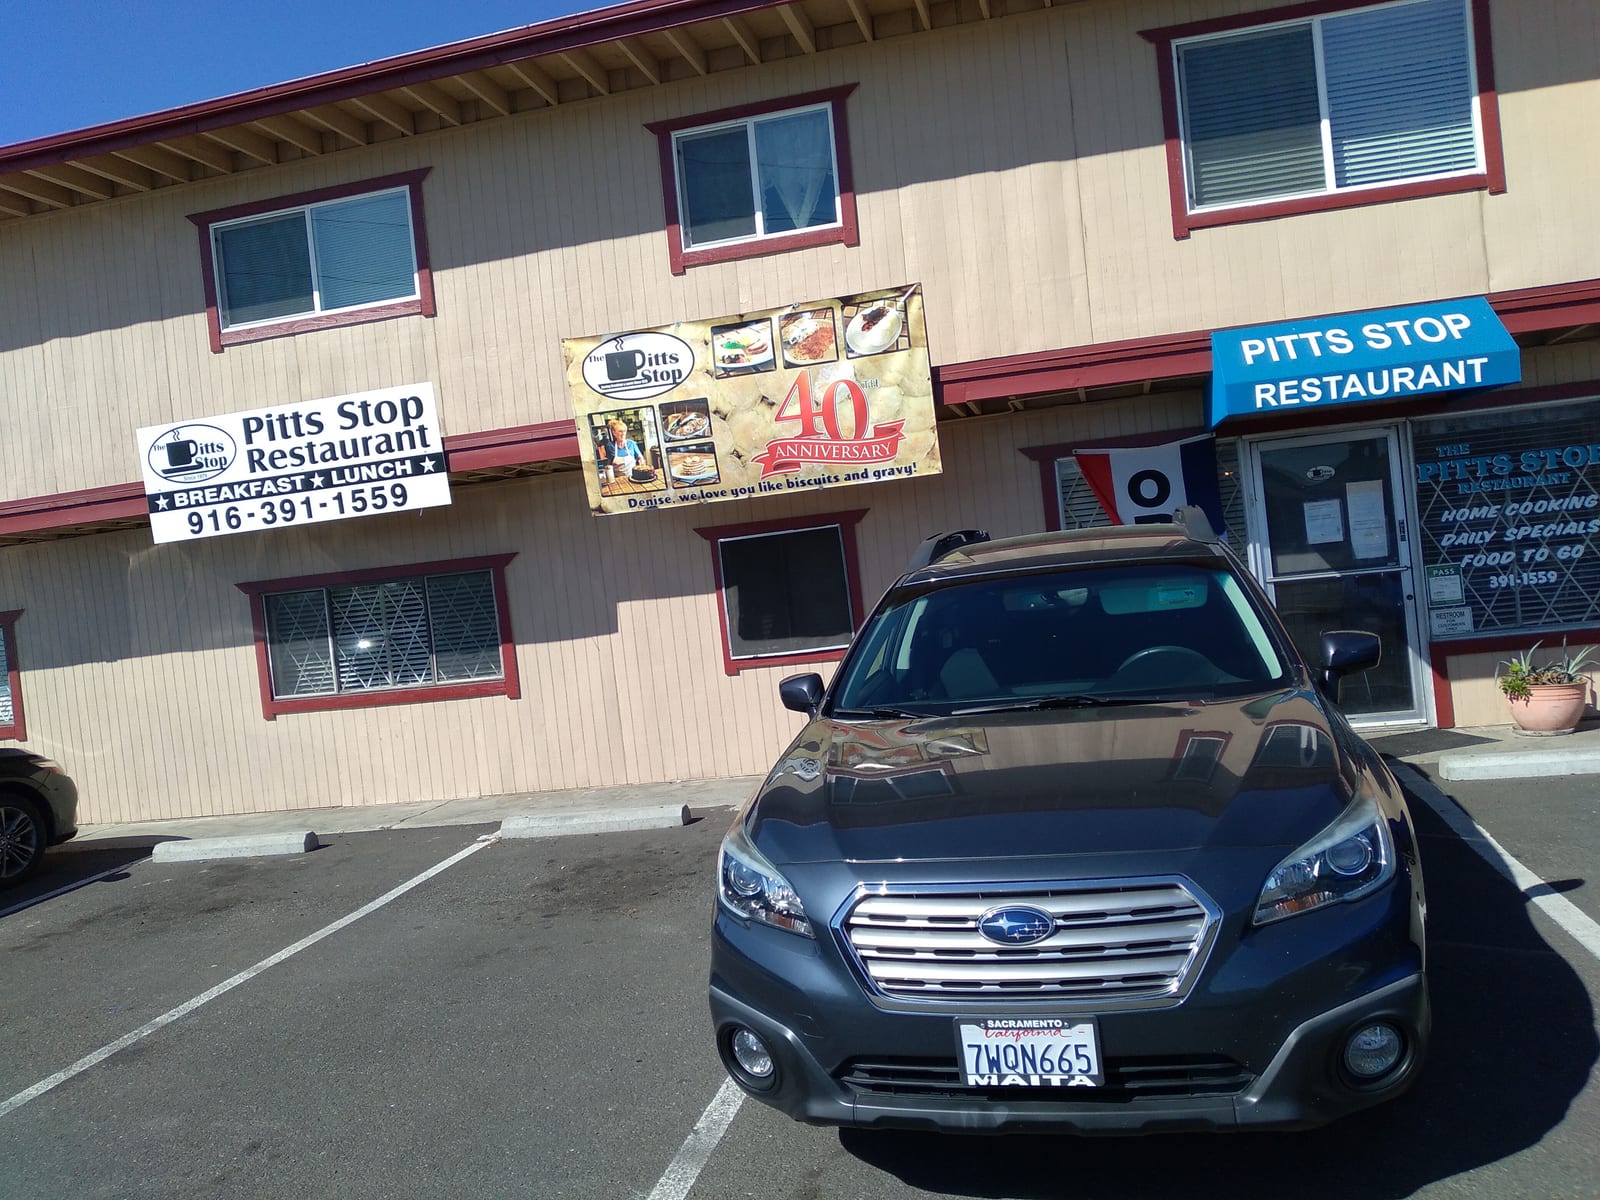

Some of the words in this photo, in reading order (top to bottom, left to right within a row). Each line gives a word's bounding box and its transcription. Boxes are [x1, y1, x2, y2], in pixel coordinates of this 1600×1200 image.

[1241, 329, 1354, 366] PITTS
[1362, 313, 1472, 350] STOP
[588, 355, 606, 363] The
[640, 368, 682, 385] Stop
[1254, 357, 1489, 409] RESTAURANT
[775, 369, 870, 441] 40
[242, 411, 325, 445] Pitts
[337, 395, 424, 430] Stop
[247, 424, 431, 473] Restaurant
[775, 442, 891, 458] ANNIVERSARY
[1436, 443, 1471, 457] THE
[195, 456, 227, 469] Stop
[1417, 454, 1514, 483] PITTS
[173, 475, 304, 509] BREAKFAST
[332, 460, 412, 487] LUNCH
[628, 494, 676, 508] Denise,
[679, 490, 698, 501] we
[700, 488, 728, 499] love
[730, 483, 756, 498] you
[758, 480, 784, 493] like
[786, 474, 840, 489] biscuits
[843, 468, 870, 481] and
[872, 462, 918, 480] gravy!
[1458, 472, 1571, 494] RESTAURANT
[187, 483, 409, 535] 916-391-1559
[1440, 505, 1500, 522] HOME
[1504, 494, 1600, 516] COOKING
[1440, 531, 1497, 547] DAILY
[1503, 519, 1600, 542] SPECIALS
[1460, 551, 1516, 568] FOOD
[1522, 548, 1549, 563] TO
[1556, 544, 1585, 559] GO
[1433, 568, 1455, 576] PASS
[1489, 570, 1558, 588] 391-1559
[985, 1028, 1072, 1042] California
[987, 1019, 1063, 1029] SACRAMENTO
[968, 1044, 1092, 1074] 7WQN665
[967, 1073, 1097, 1087] MAITA
